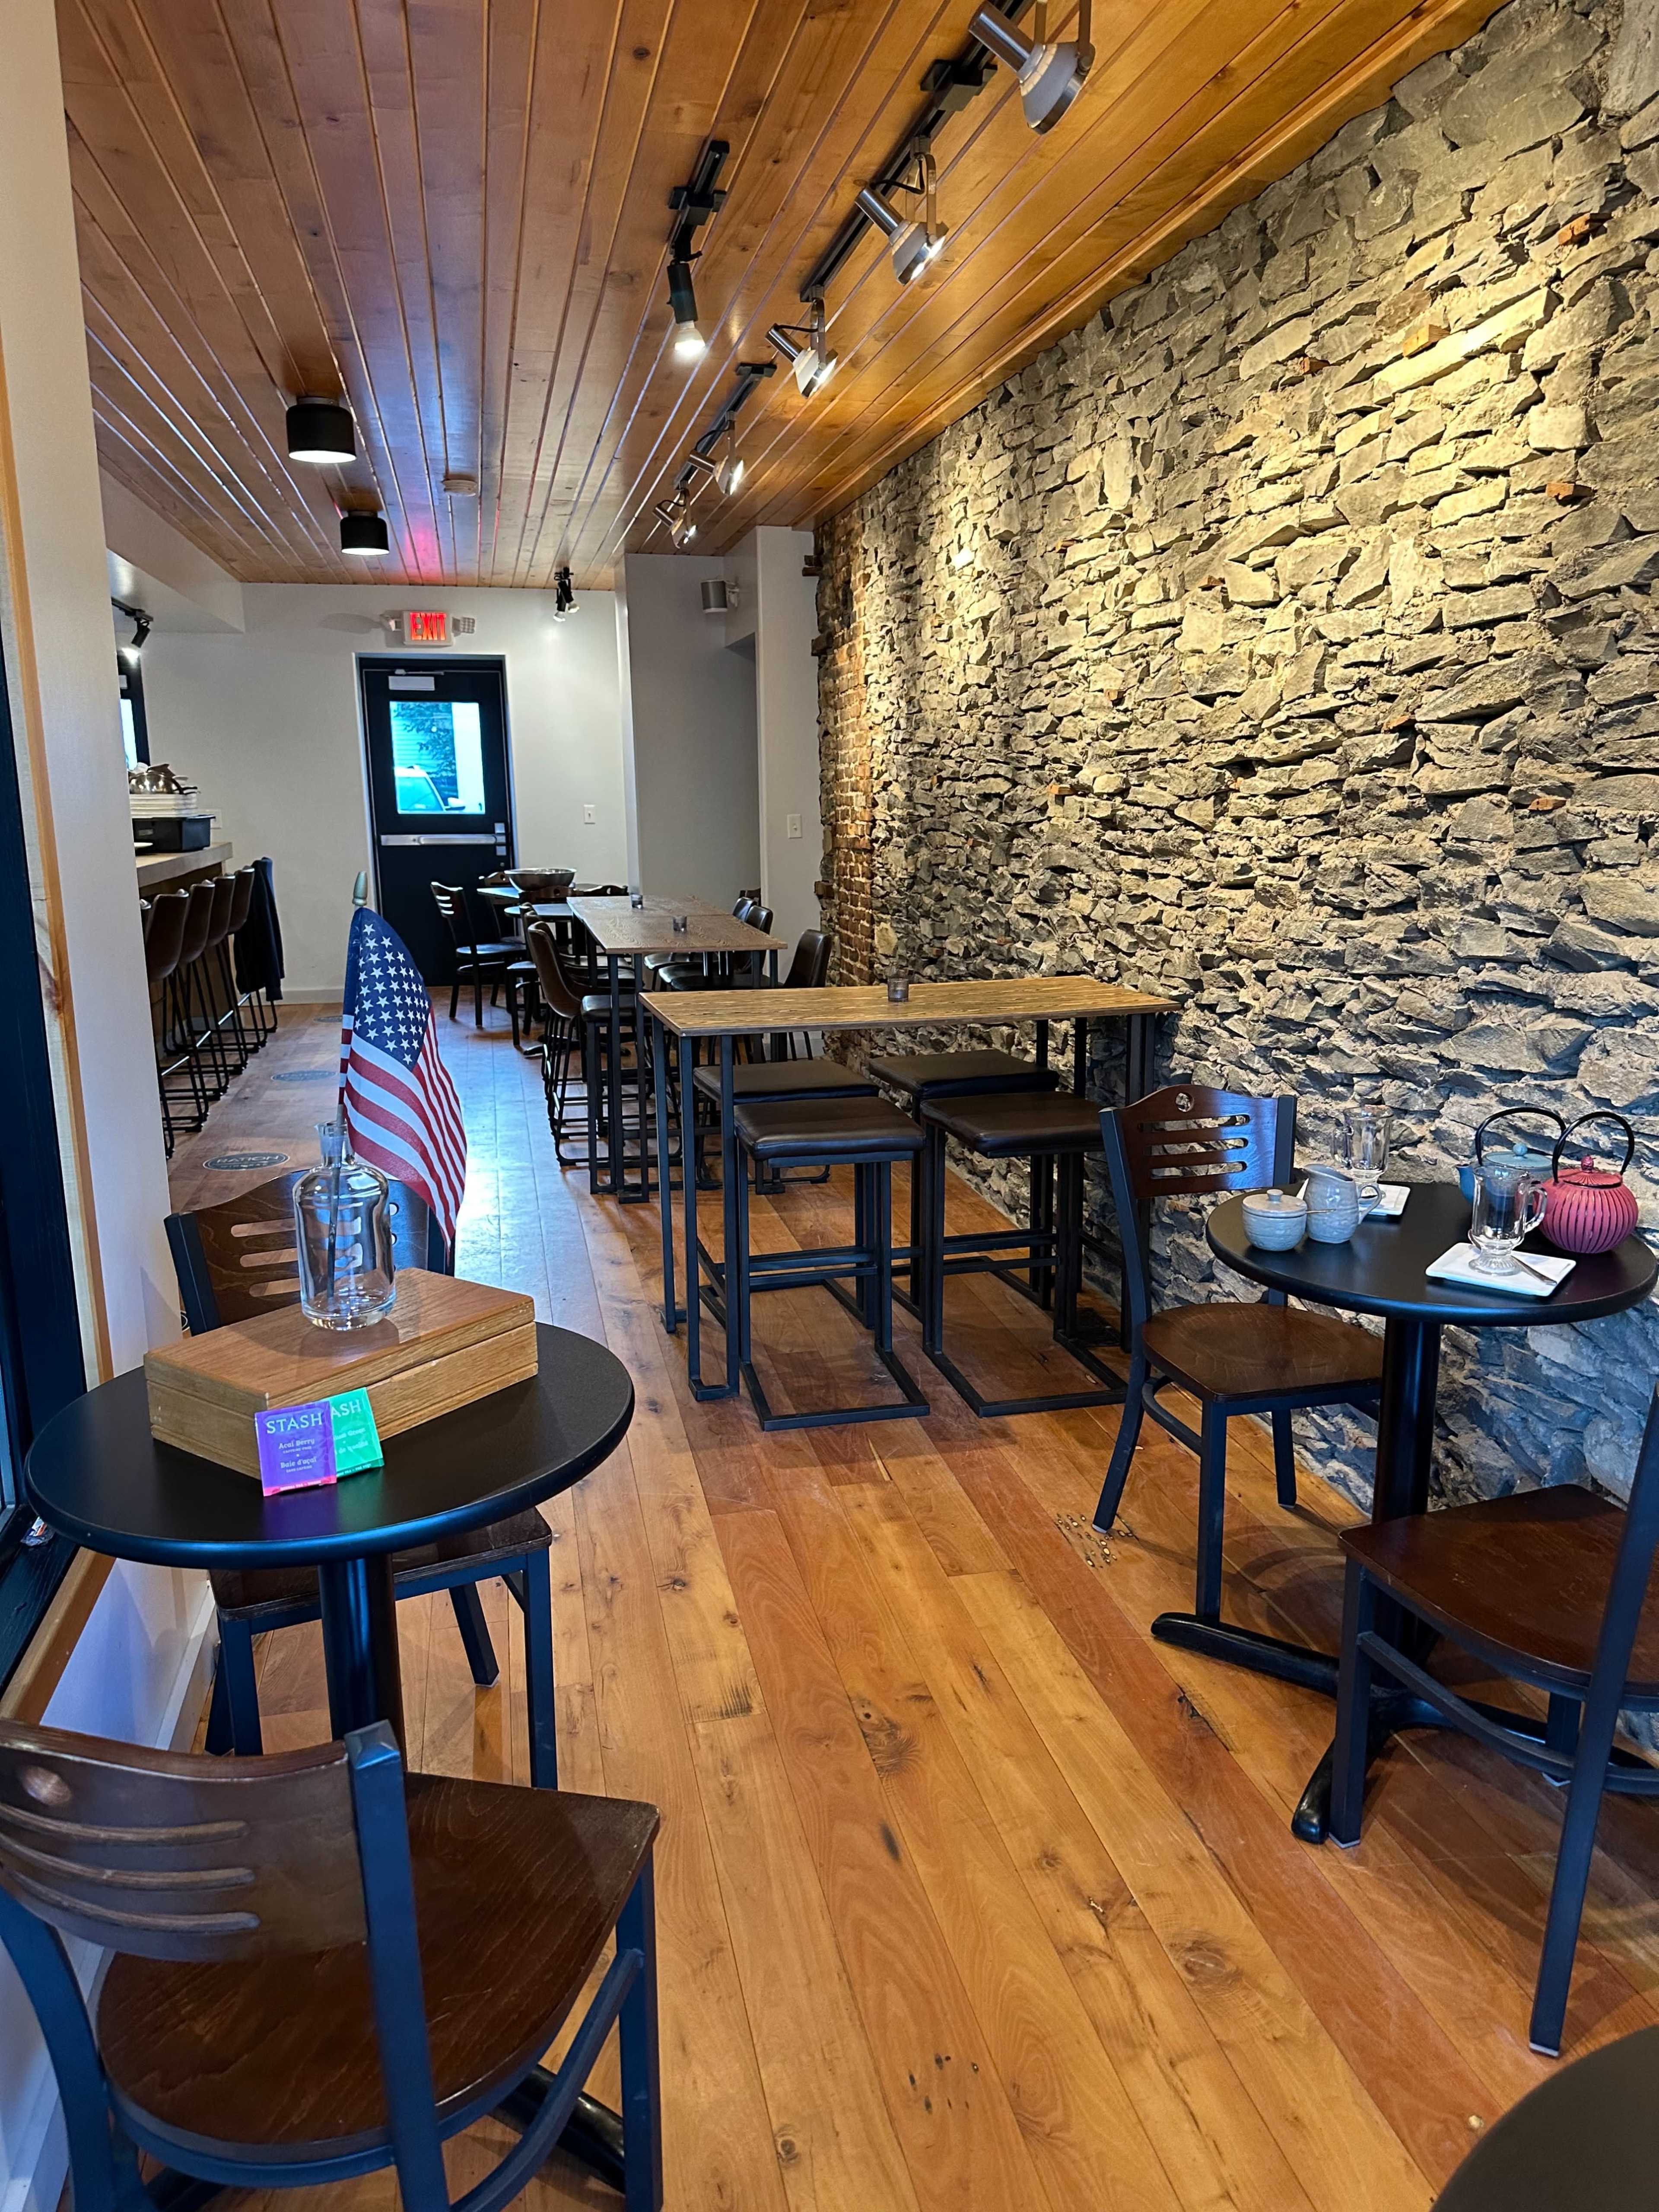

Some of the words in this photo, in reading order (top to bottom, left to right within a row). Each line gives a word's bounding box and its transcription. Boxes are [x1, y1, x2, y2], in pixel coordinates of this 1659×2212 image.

[410, 612, 446, 640] EXIT
[331, 1399, 362, 1417] ASH
[266, 1412, 323, 1434] STASH
